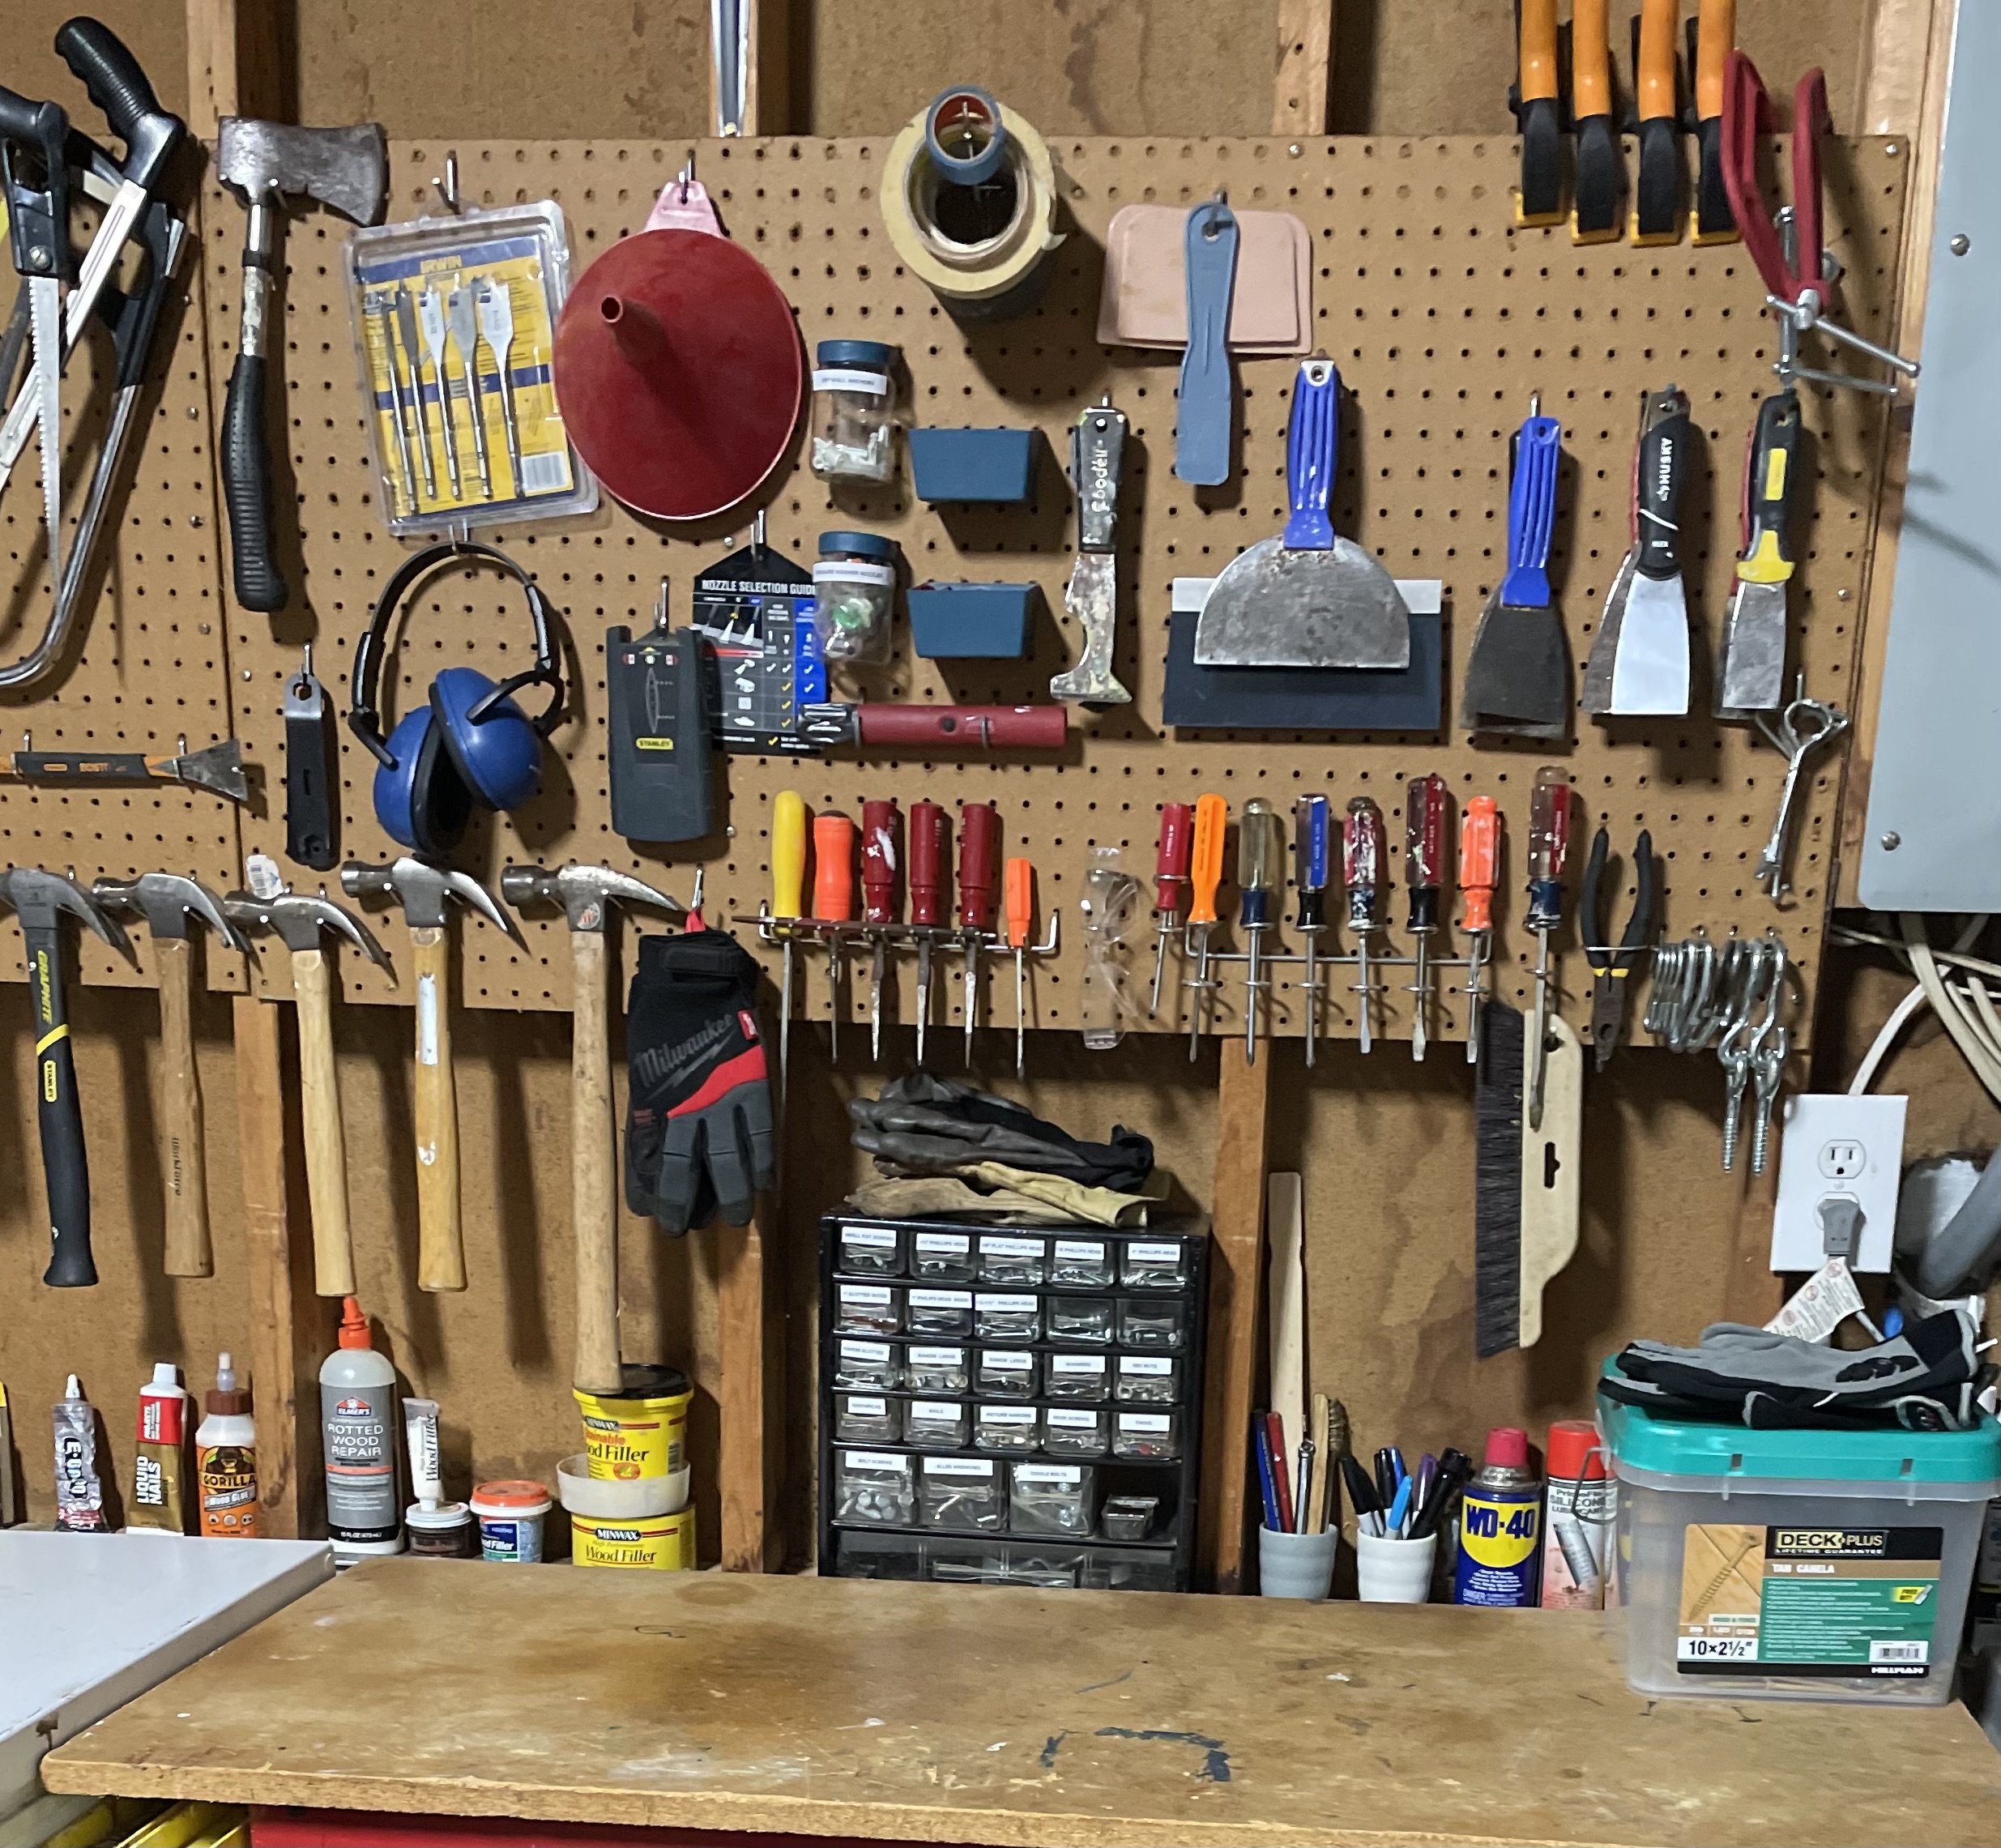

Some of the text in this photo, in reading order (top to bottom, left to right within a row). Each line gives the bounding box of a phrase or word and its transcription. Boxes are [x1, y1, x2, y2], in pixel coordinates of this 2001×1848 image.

[1658, 437, 1673, 485] HUSKY
[702, 579, 737, 591] NOZZLE
[738, 581, 788, 594] SELECTION
[38, 950, 53, 1025] GRAPHITE
[634, 1014, 733, 1088] Milwaukee
[327, 1423, 384, 1436] ROTTED
[332, 1435, 379, 1446] WOOD
[331, 1445, 382, 1457] REPAIR
[605, 1445, 650, 1462] Filler
[425, 1445, 438, 1482] Wood
[136, 1455, 151, 1504] LIQUID
[147, 1462, 164, 1505] NAILS
[203, 1475, 256, 1487] GORILLA
[1466, 1504, 1536, 1539] WD-40
[597, 1529, 640, 1540] MINWAX
[1781, 1534, 1883, 1547] DECK PLUS
[491, 1539, 514, 1551] Filler
[586, 1544, 657, 1562] Wood Filler
